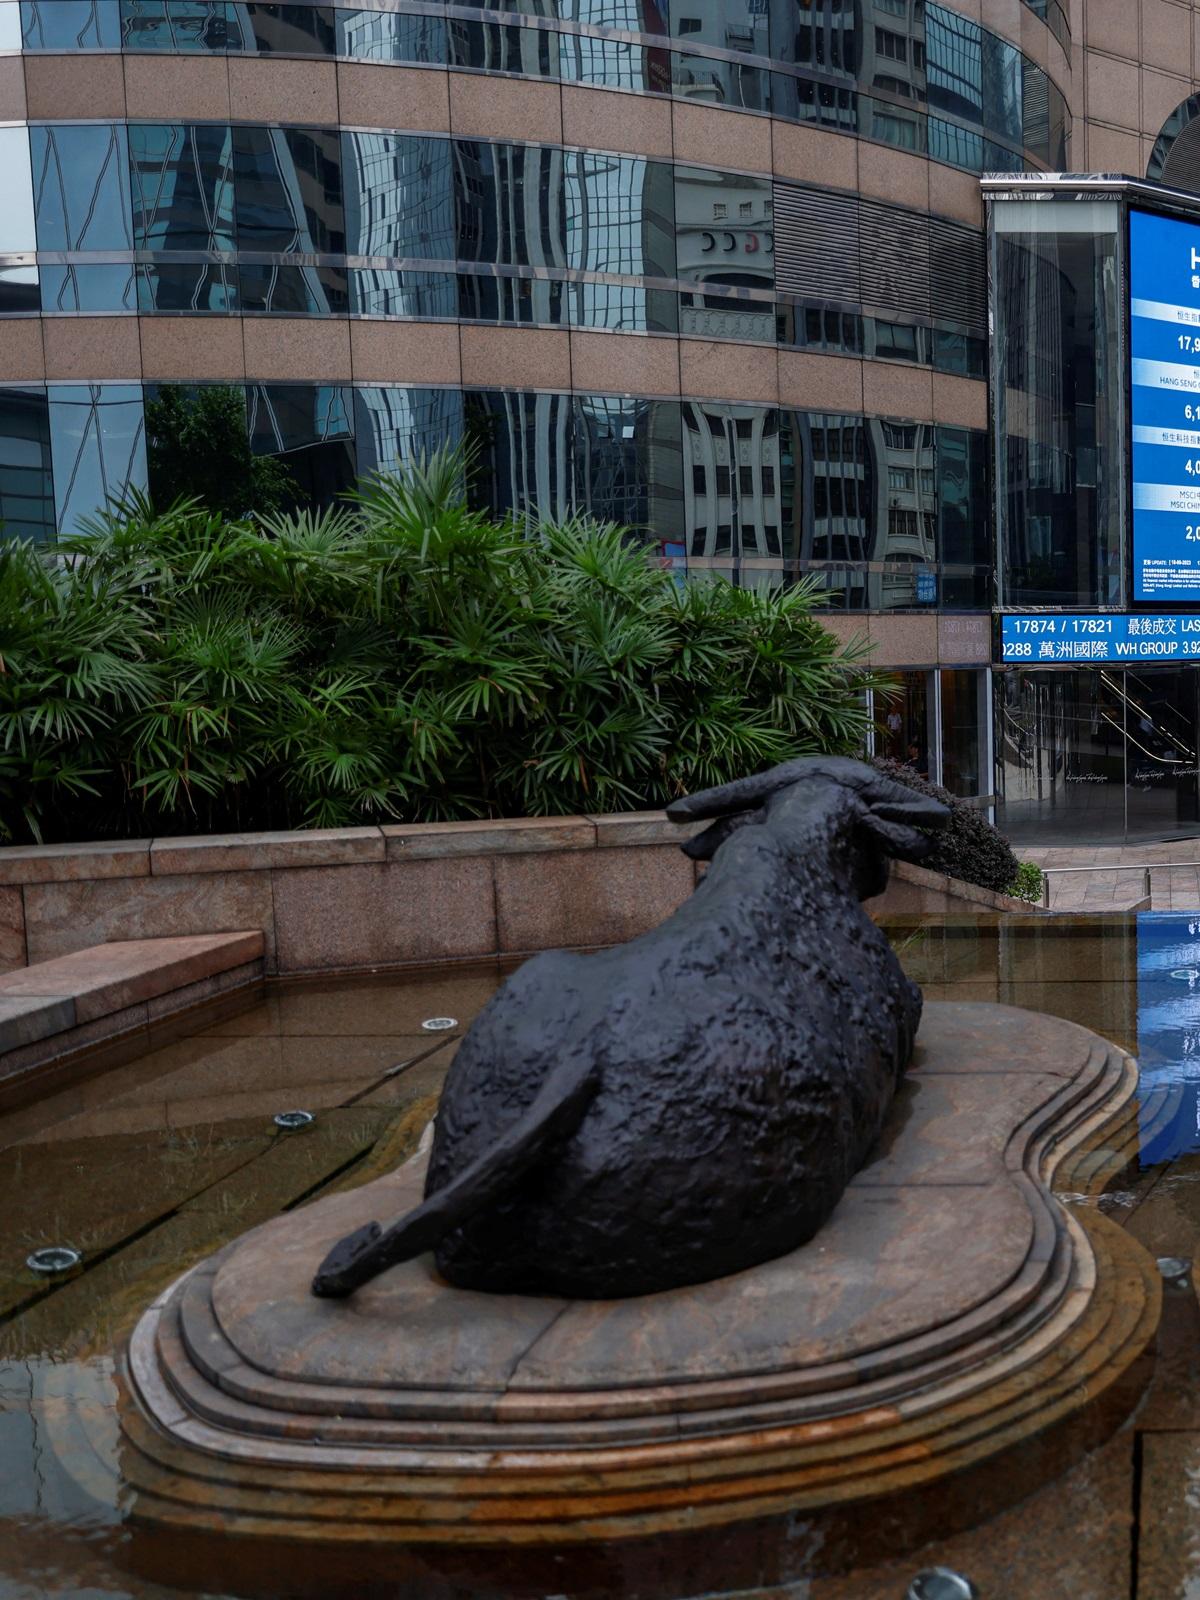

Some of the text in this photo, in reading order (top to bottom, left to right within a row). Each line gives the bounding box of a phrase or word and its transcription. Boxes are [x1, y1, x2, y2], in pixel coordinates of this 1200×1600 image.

[1160, 376, 1179, 386] HANG
[1180, 379, 1197, 388] SENG
[1014, 620, 1056, 633] 17874
[1072, 620, 1112, 633] 17821
[1127, 618, 1176, 635] 最後成交
[1039, 640, 1108, 658] 萬洲國際
[1116, 642, 1137, 655] WH
[1140, 642, 1178, 655] GROUP
